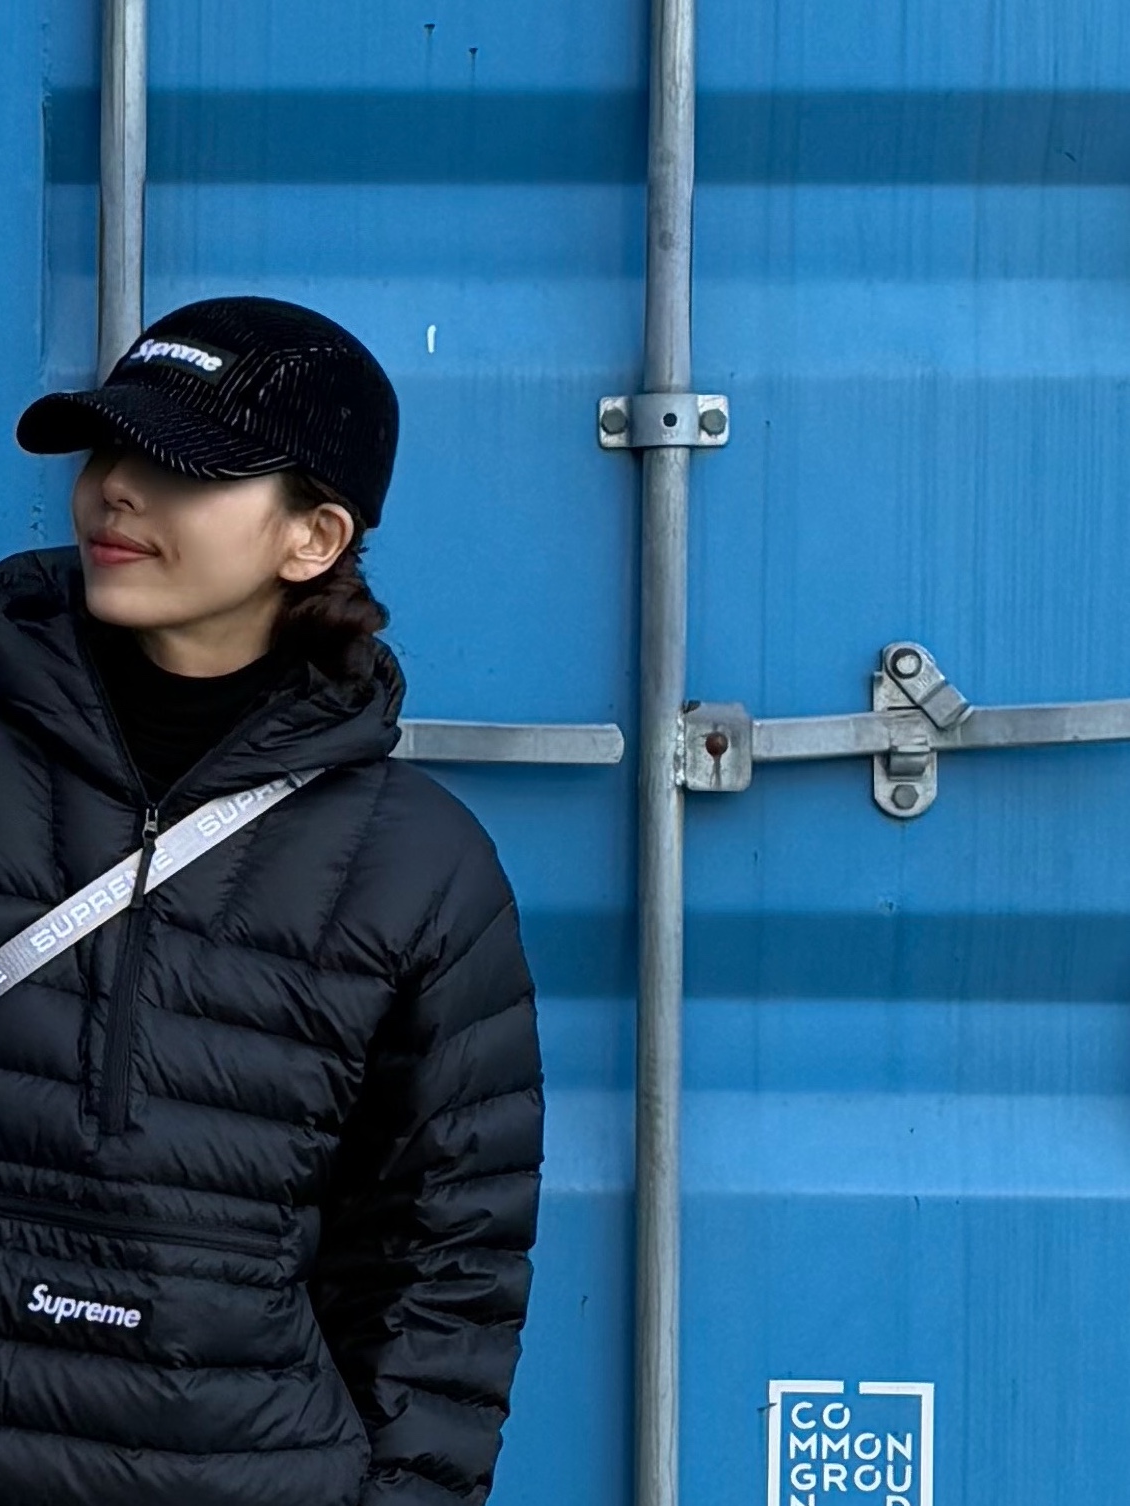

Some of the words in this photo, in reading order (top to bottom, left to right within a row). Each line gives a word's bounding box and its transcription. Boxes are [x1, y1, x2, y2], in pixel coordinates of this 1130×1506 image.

[27, 1283, 142, 1328] Supreme
[791, 1401, 851, 1429] CO
[789, 1432, 912, 1461] MMON
[790, 1463, 912, 1492] GROU
